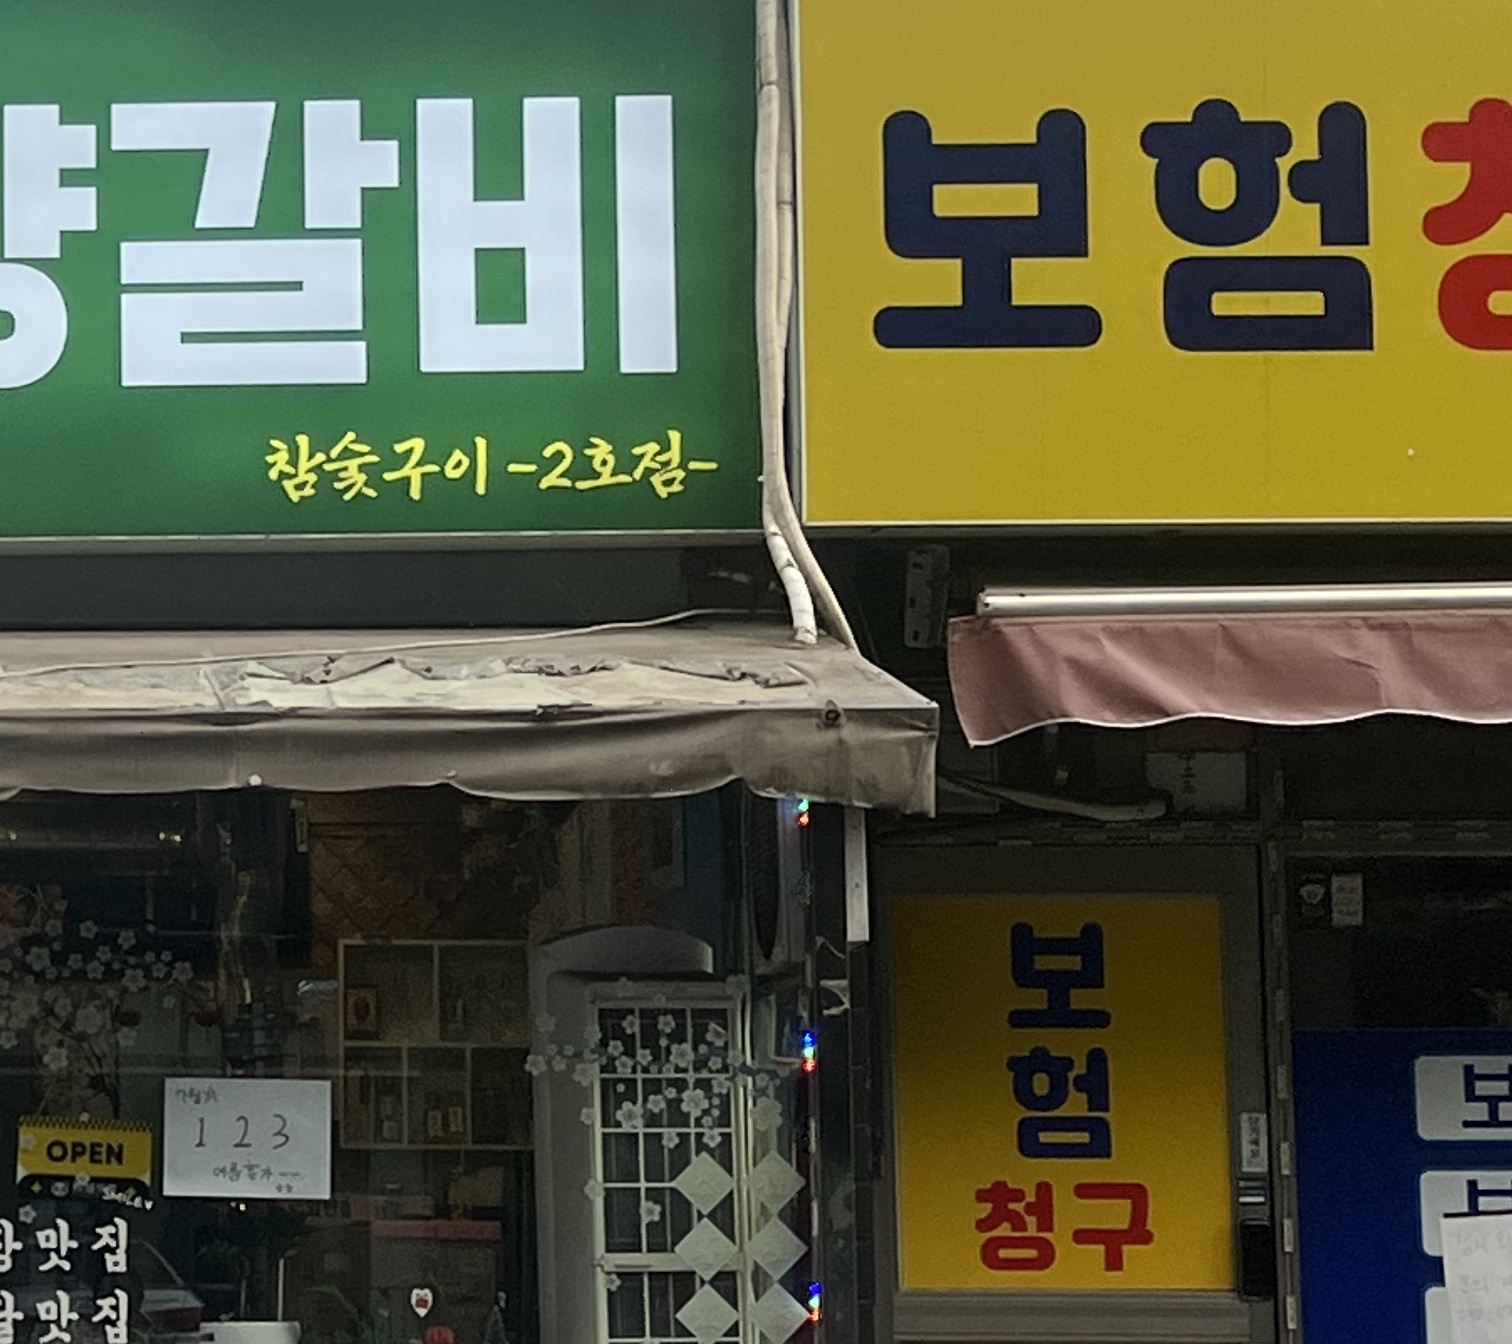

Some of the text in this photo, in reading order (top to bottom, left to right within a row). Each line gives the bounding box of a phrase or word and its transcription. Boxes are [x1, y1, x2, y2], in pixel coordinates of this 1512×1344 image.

[265, 429, 719, 502] 참숯구이 -2호점-
[1006, 922, 1112, 1159] 보험
[46, 1139, 125, 1166] OPEN
[975, 1180, 1154, 1272] 청구
